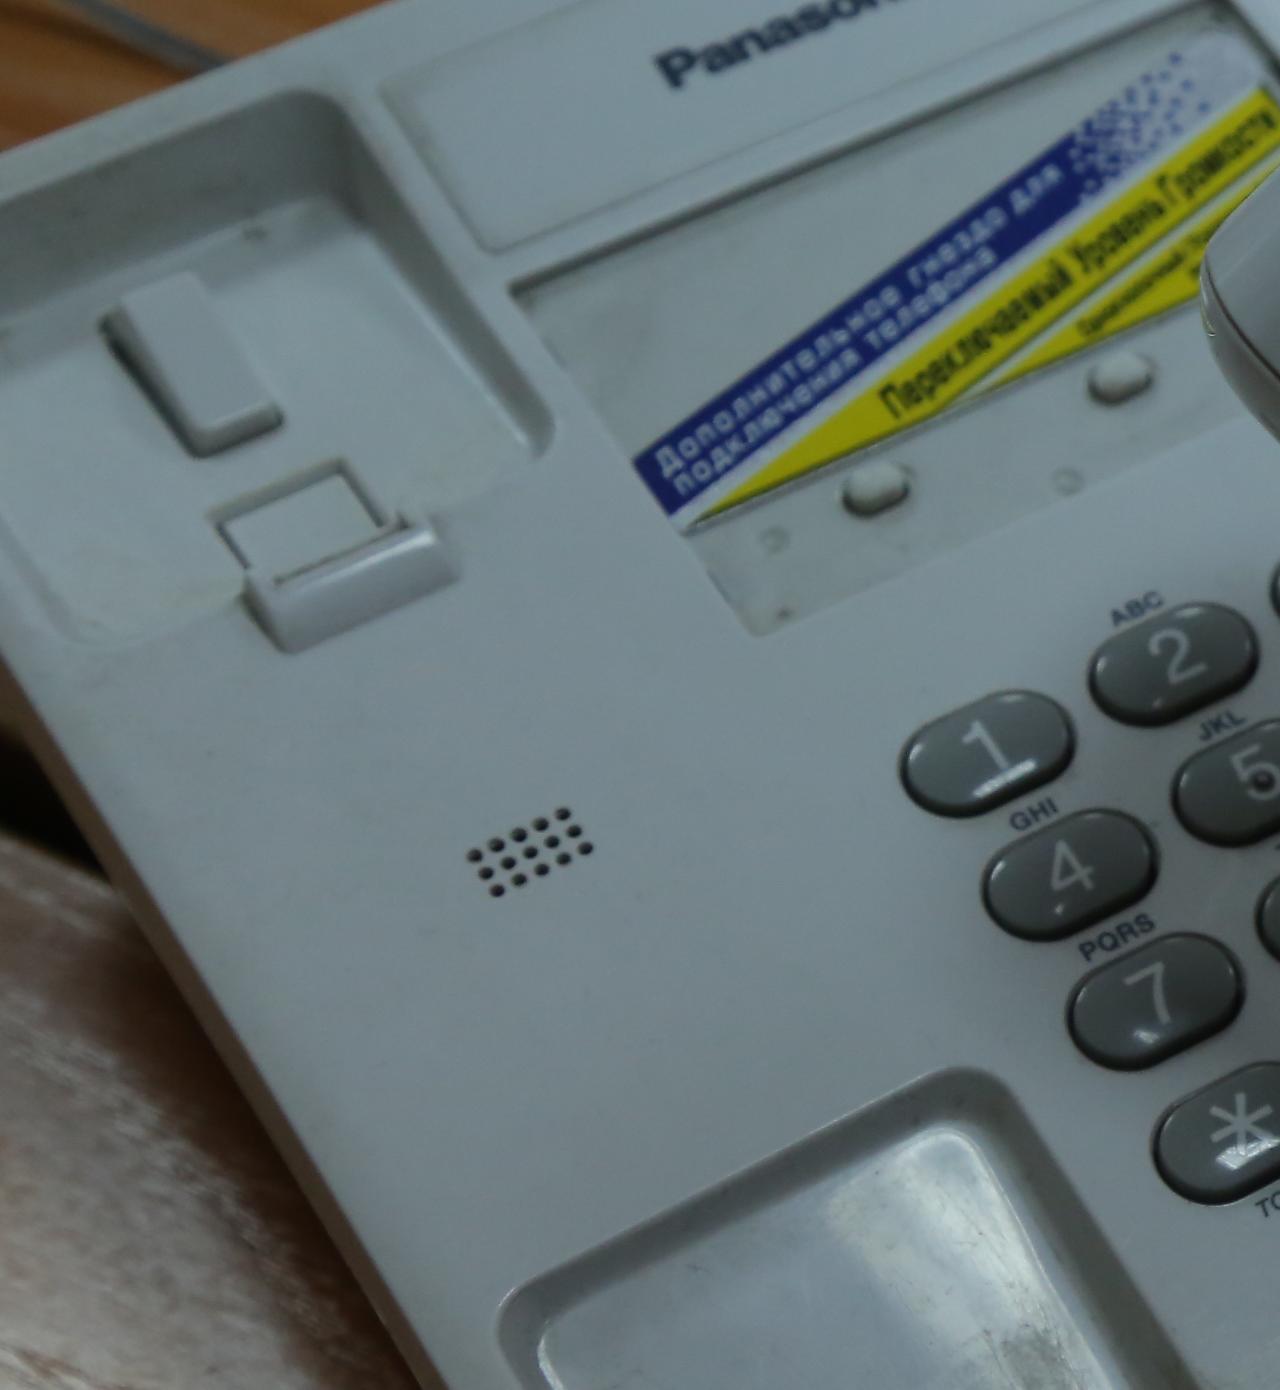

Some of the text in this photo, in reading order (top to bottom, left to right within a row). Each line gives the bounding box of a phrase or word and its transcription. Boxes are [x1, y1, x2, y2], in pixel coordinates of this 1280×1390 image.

[655, 0, 879, 88] Panaso
[654, 285, 902, 480] Дополнительное
[907, 205, 1010, 288] гнездо
[1009, 162, 1064, 217] для
[878, 255, 1074, 419] Переключаемый
[672, 347, 864, 497] подключения
[865, 245, 998, 349] телефона
[1109, 590, 1166, 628] ABC
[1148, 628, 1208, 686] 2
[961, 719, 1014, 779] 1
[1197, 709, 1246, 744] JKL
[1009, 798, 1059, 833] GHI
[1047, 839, 1096, 893] 4
[1077, 913, 1157, 962] PQRS
[1123, 961, 1173, 1026] 7
